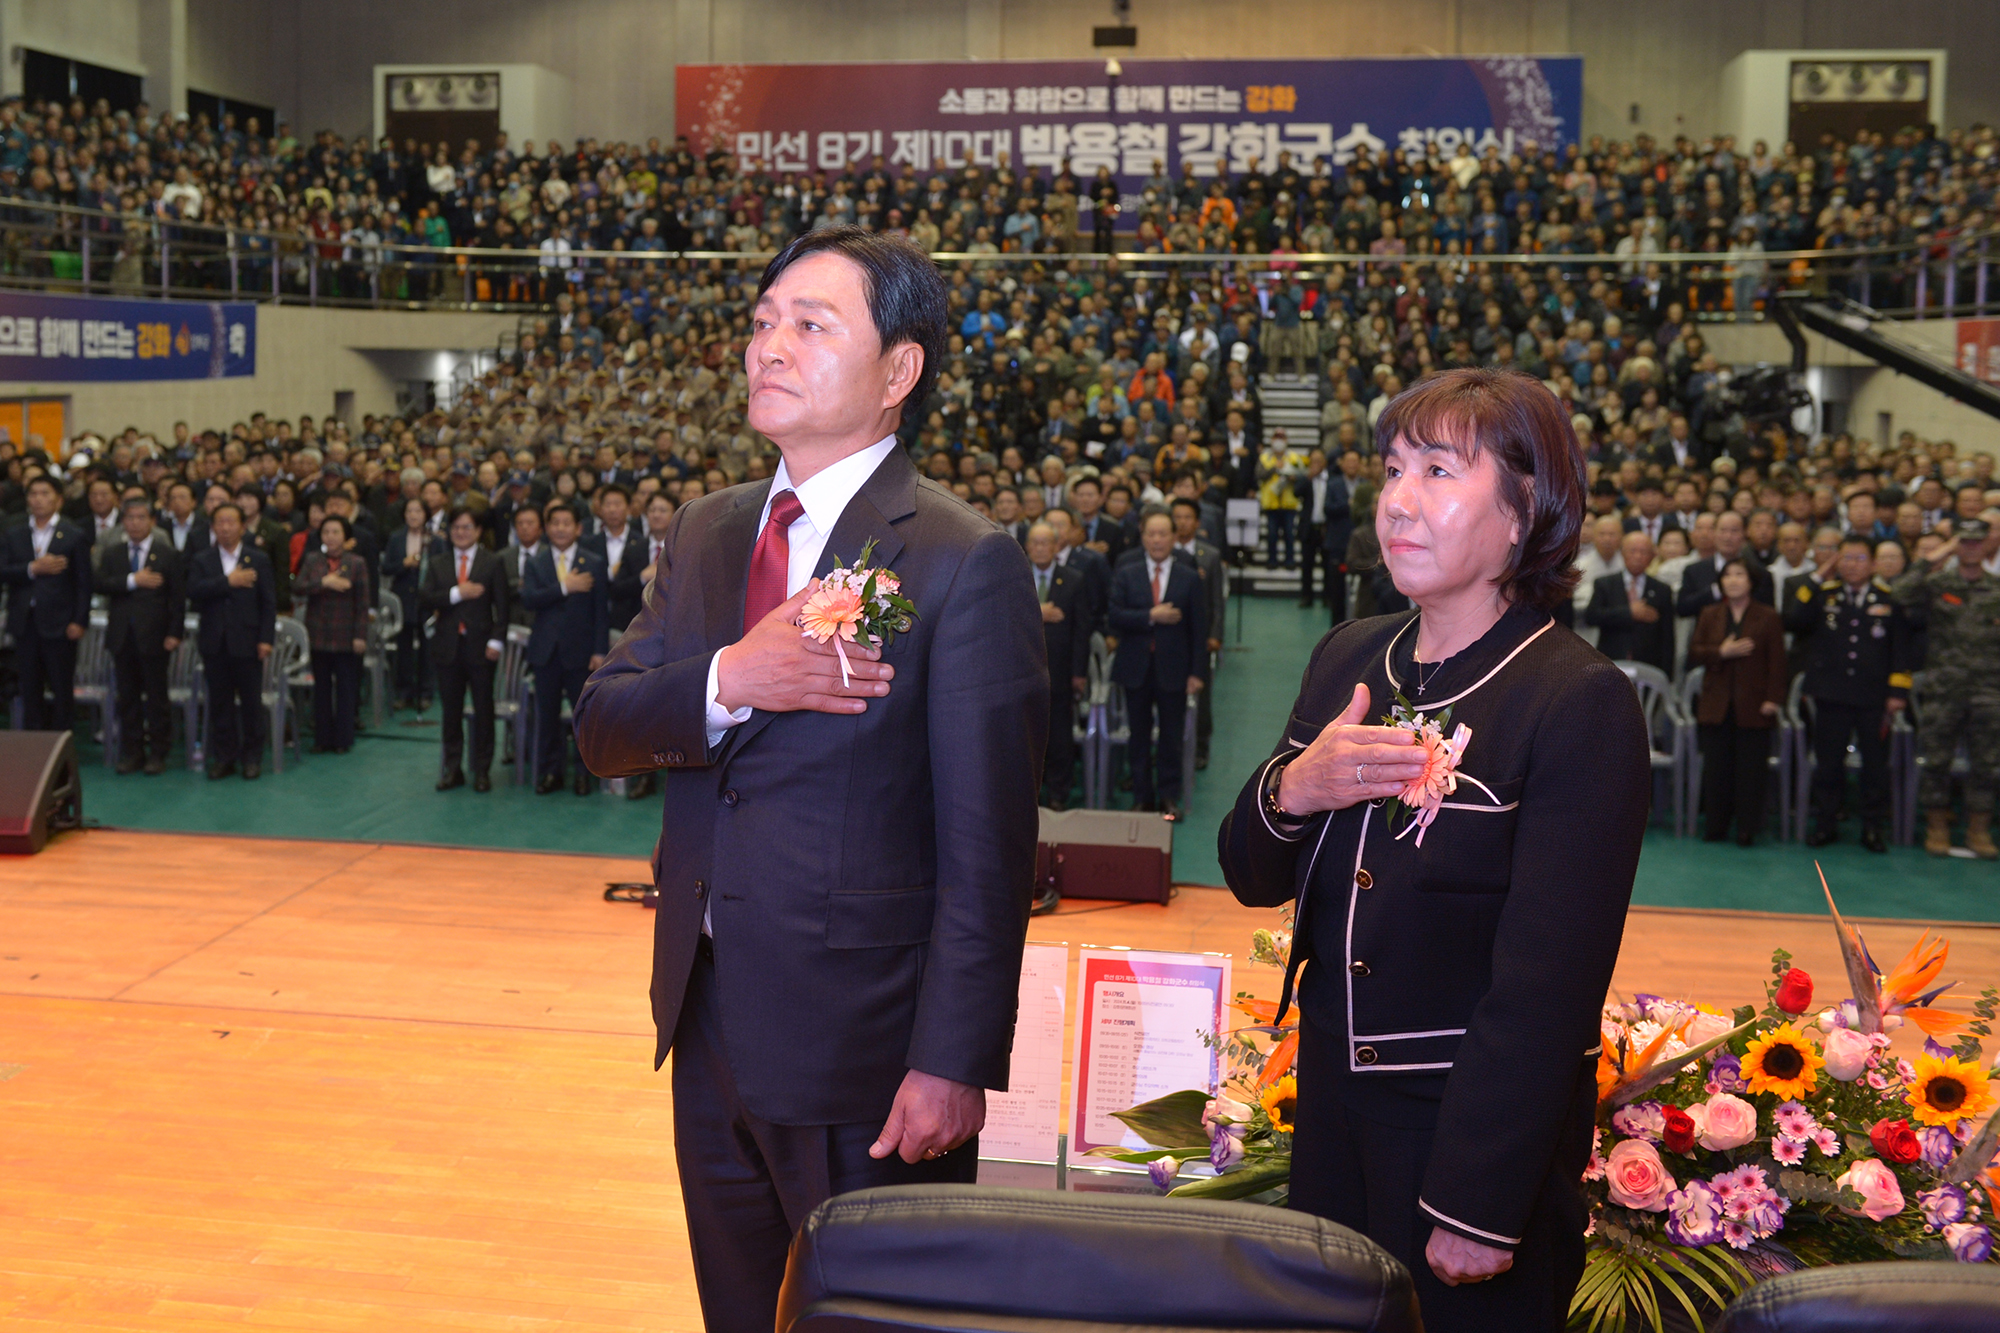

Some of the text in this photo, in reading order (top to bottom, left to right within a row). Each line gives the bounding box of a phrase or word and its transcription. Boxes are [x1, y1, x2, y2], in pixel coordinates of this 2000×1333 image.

[938, 85, 1297, 114] 소통과 화합으로 함께 만드는 강화
[736, 130, 809, 172] 민선
[817, 129, 883, 169] 8기
[889, 128, 1013, 171] 제10대
[1019, 122, 1169, 177] 박용철
[1177, 121, 1387, 177] 강화군수
[0, 316, 38, 357] 으로
[39, 317, 80, 359] 함께
[82, 320, 135, 360] 만드는
[136, 322, 171, 360] 강화
